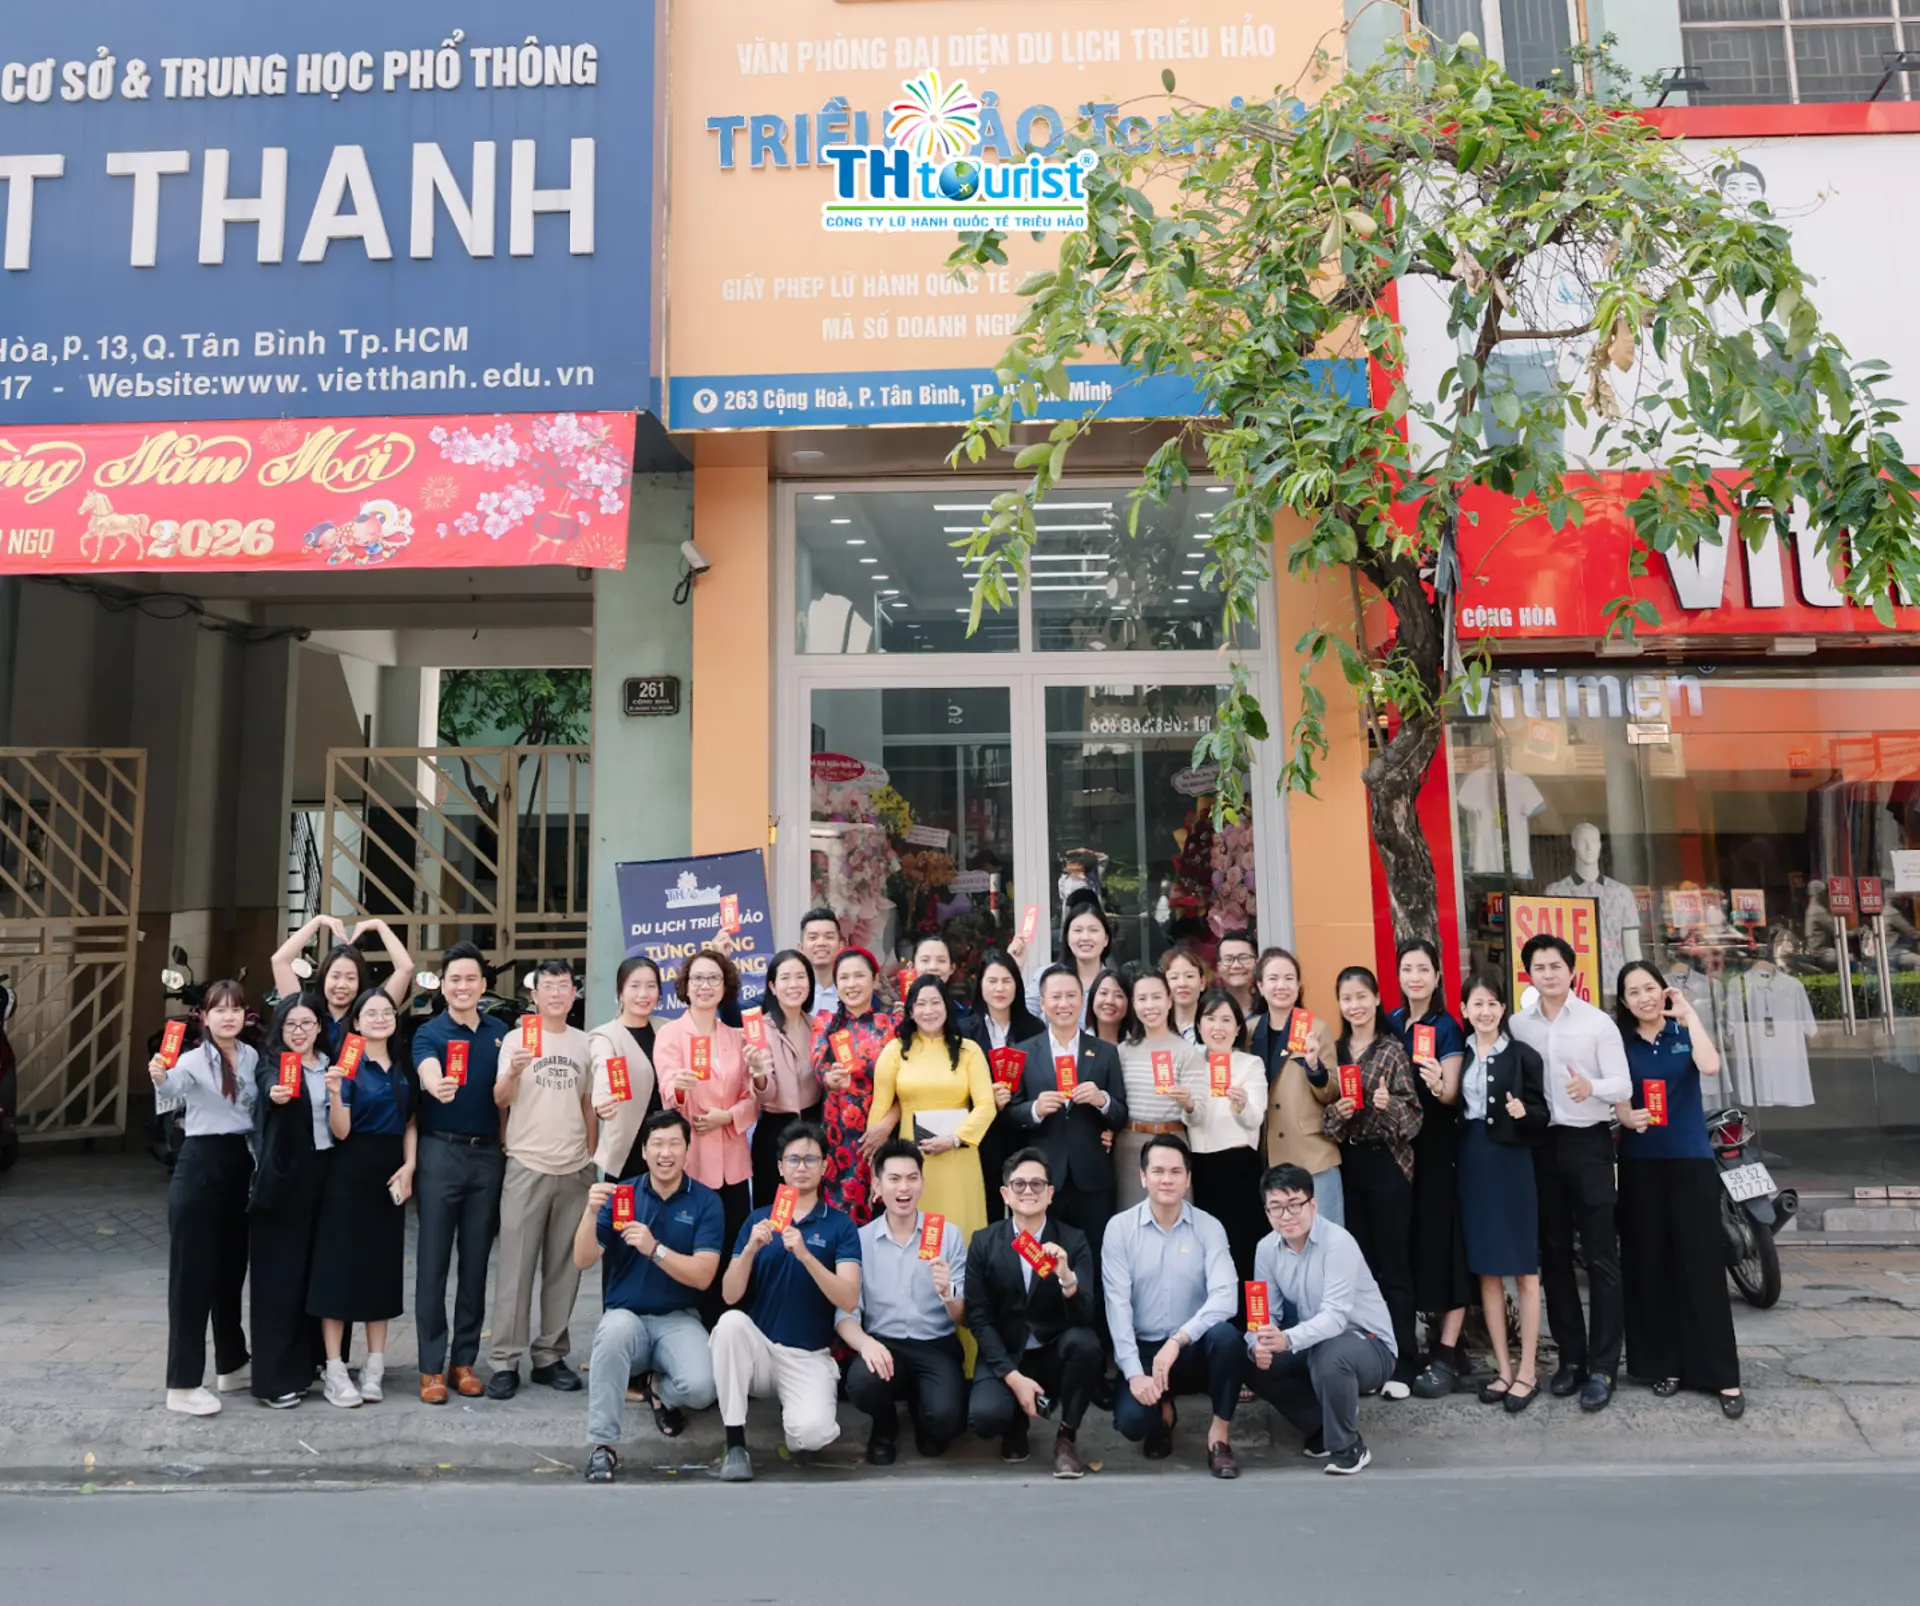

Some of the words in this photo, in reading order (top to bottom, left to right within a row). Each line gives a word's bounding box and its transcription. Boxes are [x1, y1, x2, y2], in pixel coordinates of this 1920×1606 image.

[736, 36, 788, 75] VĂN
[797, 31, 888, 72] PHÒNG
[948, 26, 1010, 75] DIỆN
[1017, 31, 1053, 65] DU
[1061, 28, 1121, 71] LỊCH
[1131, 14, 1209, 62] TRIỀU
[1220, 13, 1276, 58] HẢO
[2, 58, 56, 102] CƠ
[61, 45, 116, 101] SỞ
[121, 58, 152, 100] &
[160, 53, 288, 98] TRUNG
[296, 50, 374, 101] HỌC
[383, 28, 466, 92] PHỔ
[470, 35, 598, 89] THÔNG
[106, 137, 596, 268] THANH
[773, 271, 825, 299] PHÉP
[863, 269, 920, 297] HÀNH
[986, 265, 1010, 295] TẾ
[254, 328, 326, 356] Bình
[339, 326, 469, 359] Tp.HCM
[822, 312, 856, 341] MÃ
[897, 313, 967, 339] DOANH
[723, 391, 757, 410] 263
[763, 387, 808, 415] Cộng
[815, 386, 853, 409] Hoà,
[859, 387, 875, 407] P.
[880, 385, 912, 406] Tân
[919, 383, 966, 407] Bình,
[1068, 380, 1113, 401] Minh
[93, 430, 252, 488] Năm
[257, 425, 417, 494] Mới
[8, 527, 55, 559] NGỌ
[147, 518, 275, 558] 2026
[1461, 604, 1513, 631] CỘNG
[1519, 603, 1558, 627] HÒA
[639, 681, 665, 698] 261
[1462, 668, 1703, 718] vitimen
[631, 923, 652, 936] DU
[655, 918, 686, 936] LỊCH
[701, 936, 755, 952] BNG
[1515, 904, 1590, 954] SALE
